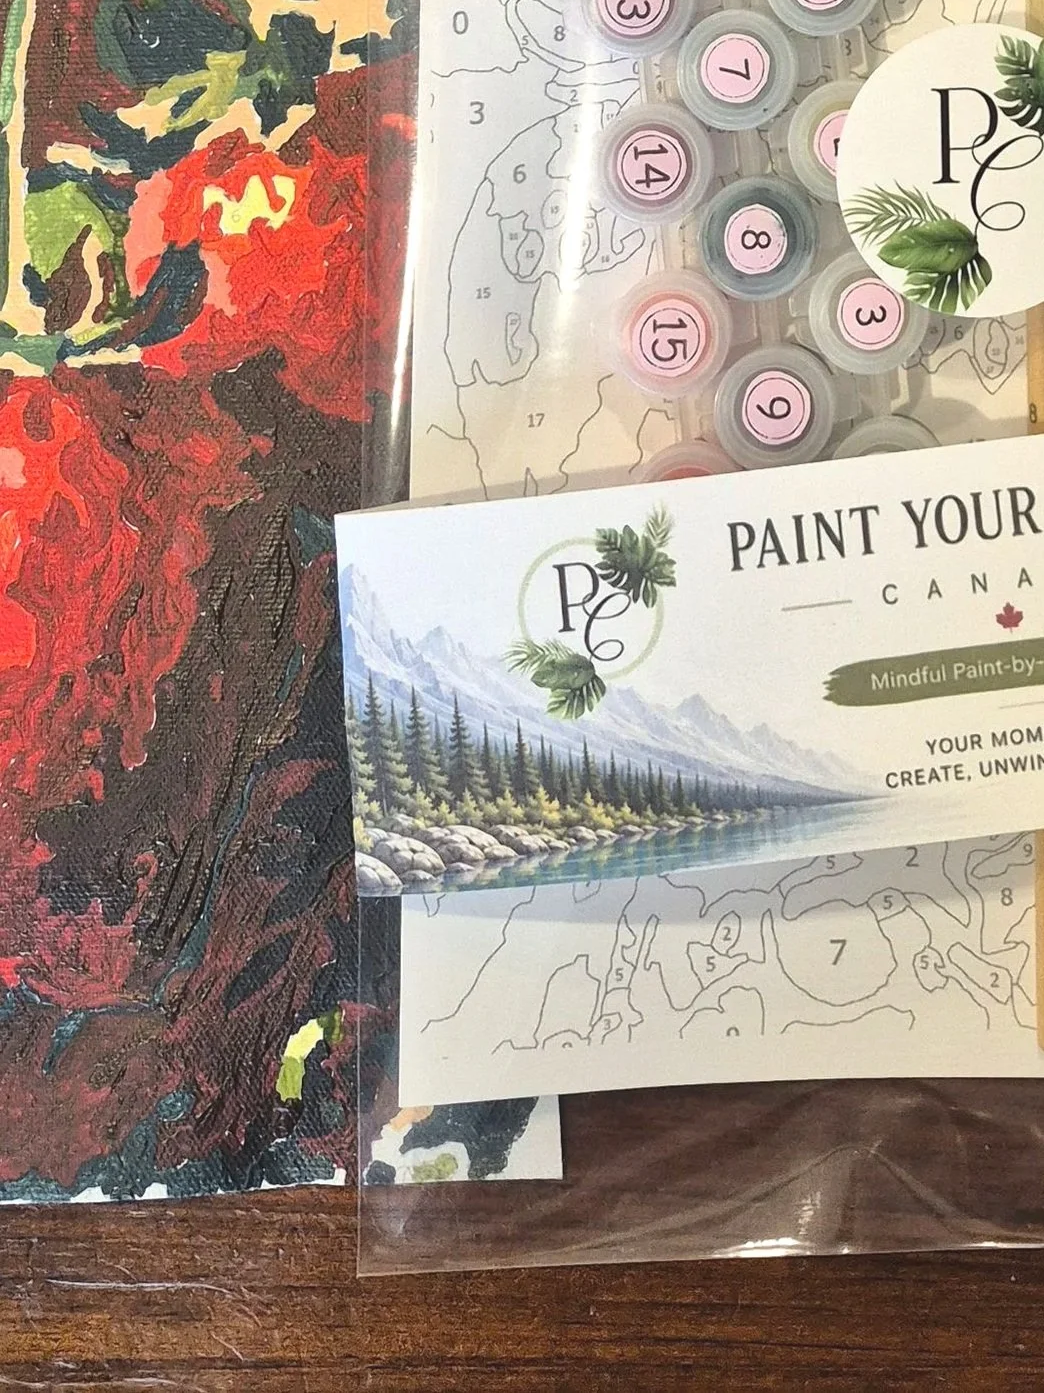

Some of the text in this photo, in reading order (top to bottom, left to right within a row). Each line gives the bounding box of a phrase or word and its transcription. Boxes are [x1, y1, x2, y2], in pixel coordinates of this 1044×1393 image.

[453, 11, 468, 34] 0
[554, 26, 564, 41] 8
[719, 59, 751, 80] 7
[570, 90, 578, 101] 2
[470, 102, 484, 124] 3
[513, 164, 526, 183] 6
[633, 144, 670, 188] 14
[741, 230, 771, 249] 8
[476, 288, 490, 298] 15
[856, 306, 887, 326] 3
[652, 319, 687, 361] 15
[954, 325, 963, 340] 6
[756, 397, 791, 418] 9
[1029, 403, 1037, 423] 8
[528, 414, 544, 427] 17
[727, 505, 879, 571] PAINT
[901, 486, 1043, 548] YOUR
[871, 666, 947, 691] Mindful
[926, 734, 983, 755] YOUR
[885, 764, 972, 789] CREATE,
[906, 847, 918, 867] 2
[884, 896, 892, 909] 5
[1001, 889, 1012, 905] 8
[723, 928, 731, 940] 2
[830, 940, 846, 965] 7
[706, 958, 715, 972] 5
[920, 956, 928, 969] 5
[616, 969, 623, 981] 5
[991, 973, 999, 987] 2
